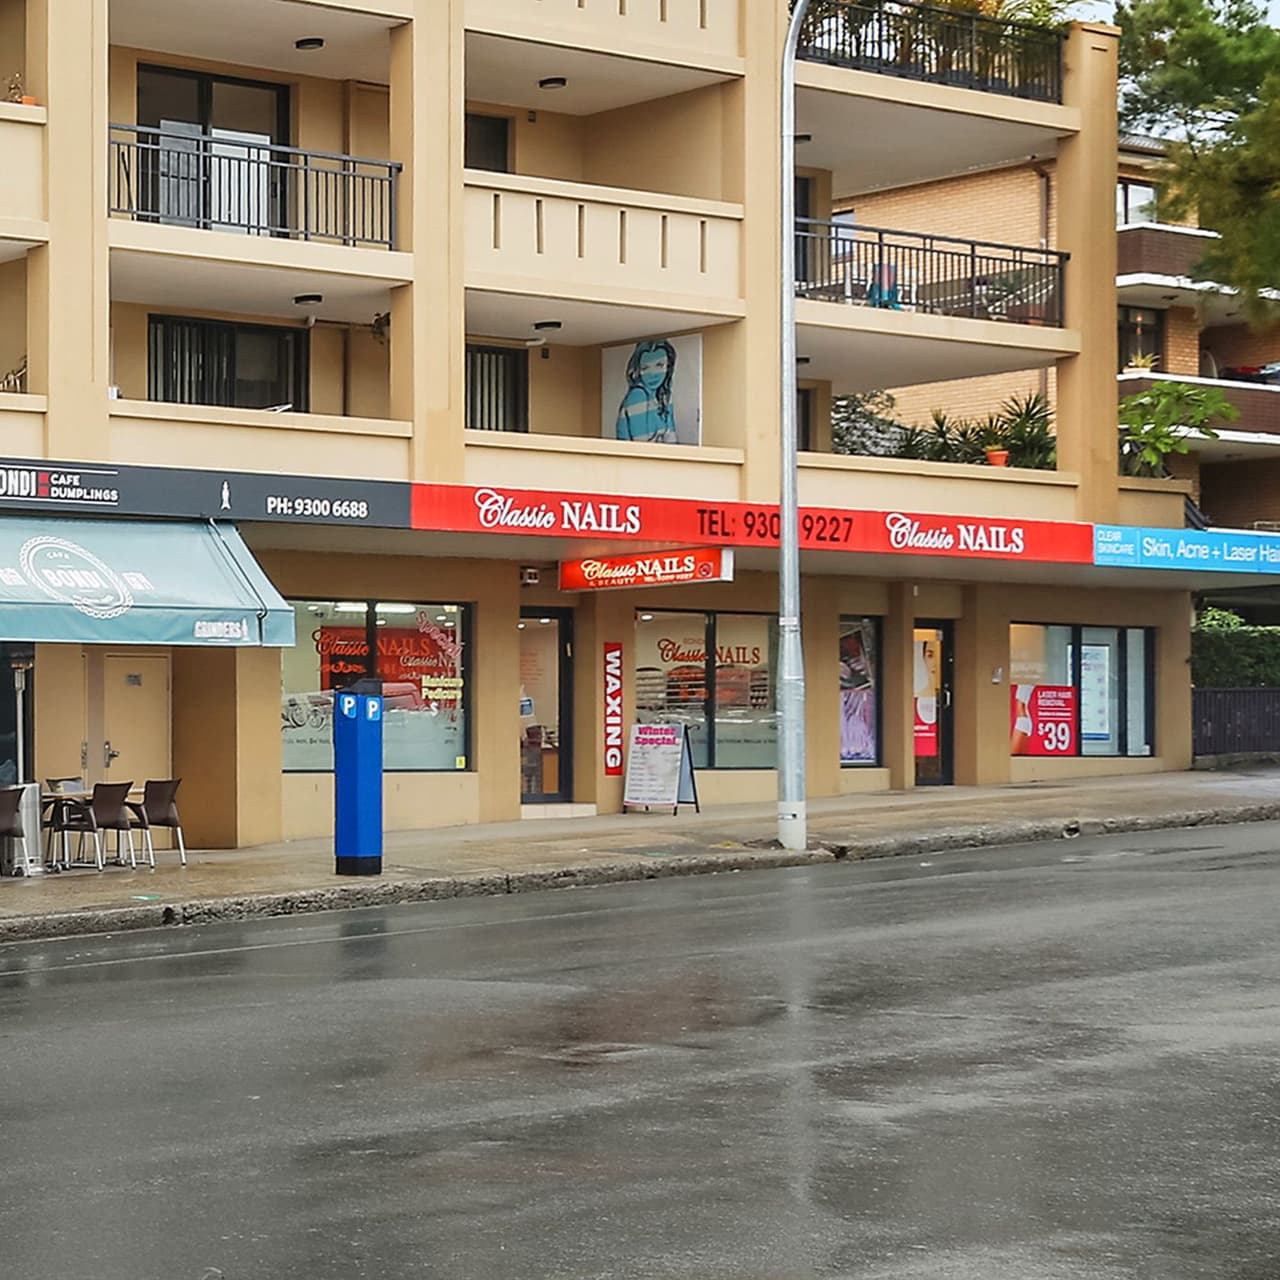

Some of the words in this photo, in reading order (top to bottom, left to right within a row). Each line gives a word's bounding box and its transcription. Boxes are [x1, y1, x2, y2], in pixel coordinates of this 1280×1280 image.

[50, 475, 80, 487] CAFE
[50, 486, 118, 501] DUMPLINGS
[267, 496, 292, 515] PH:
[294, 498, 330, 517] 9300
[332, 500, 368, 518] 6688
[474, 489, 555, 529] Classic
[561, 501, 640, 534] NAILS
[697, 508, 735, 538] TEL:
[744, 511, 781, 540] 930
[802, 517, 853, 543] 9227
[886, 513, 954, 550] Classic
[957, 524, 1025, 553] NAILS
[1142, 536, 1175, 560] Skin,
[1177, 540, 1209, 559] Acne
[1224, 542, 1258, 562] Laser
[41, 569, 109, 590] BONDI
[581, 559, 636, 581] Classic
[636, 556, 695, 576] NAILS
[312, 628, 370, 656] Classic
[377, 637, 431, 657] NAILS
[658, 638, 708, 663] Classic
[715, 646, 760, 664] NAILS
[344, 696, 356, 715] P
[368, 700, 378, 719] P
[606, 650, 622, 768] WAXING
[638, 726, 677, 736] Winter
